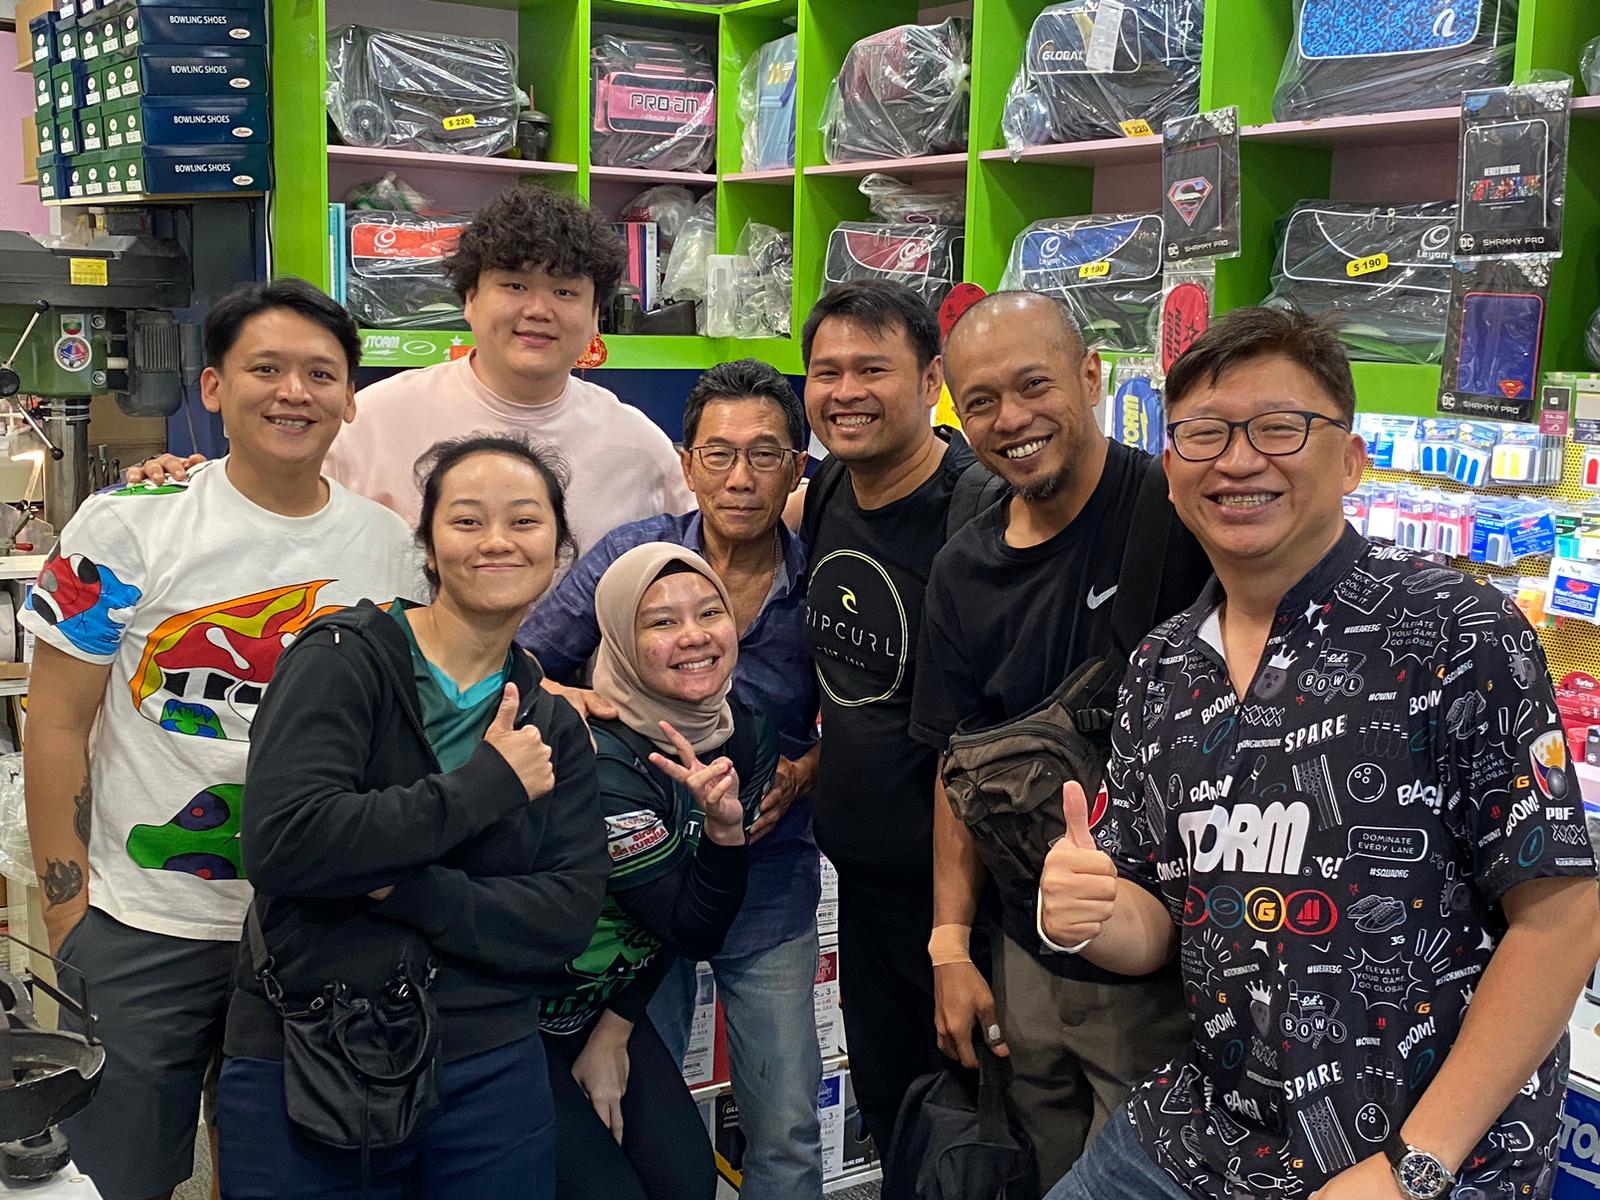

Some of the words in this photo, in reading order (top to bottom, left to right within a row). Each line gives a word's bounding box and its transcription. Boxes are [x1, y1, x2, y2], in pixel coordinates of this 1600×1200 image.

[169, 15, 203, 24] BOWLING
[203, 15, 227, 24] SHOES
[1041, 50, 1084, 61] GLOBAL
[171, 65, 204, 74] BOWLING
[204, 65, 228, 74] SHOES
[173, 115, 206, 124] BOWLING
[206, 115, 230, 124] SHOES
[455, 117, 470, 126] 220
[1132, 124, 1149, 134] 220
[175, 164, 207, 173] BOWLING
[207, 163, 231, 172] SHOES
[1213, 239, 1229, 248] PRO
[1459, 235, 1475, 248] DC
[1482, 237, 1524, 247] SHAMMY
[1524, 236, 1545, 245] PRO
[1090, 264, 1105, 274] 190
[1353, 263, 1360, 272] $
[1362, 258, 1382, 270] 190
[364, 335, 400, 349] STORM
[1462, 400, 1499, 412] SHAMMY
[1500, 405, 1519, 415] PRO
[1434, 591, 1450, 600] 3G
[1412, 628, 1438, 640] GAME
[1390, 639, 1404, 647] GO
[1284, 713, 1347, 755] SPARE
[1545, 806, 1576, 821] PBF
[1362, 833, 1413, 845] DOMINATE
[1358, 842, 1388, 852] EVERY
[1391, 845, 1415, 855] LANE
[1390, 935, 1406, 946] 3G
[1365, 964, 1401, 975] ELEVATE
[1357, 972, 1379, 982] YOUR
[1382, 975, 1406, 984] GAME
[1358, 981, 1371, 990] GO
[1301, 994, 1324, 1007] Let's
[1203, 1006, 1238, 1039] BOOM!
[1397, 1015, 1437, 1060] BOOM!
[1283, 1060, 1343, 1102] SPARE
